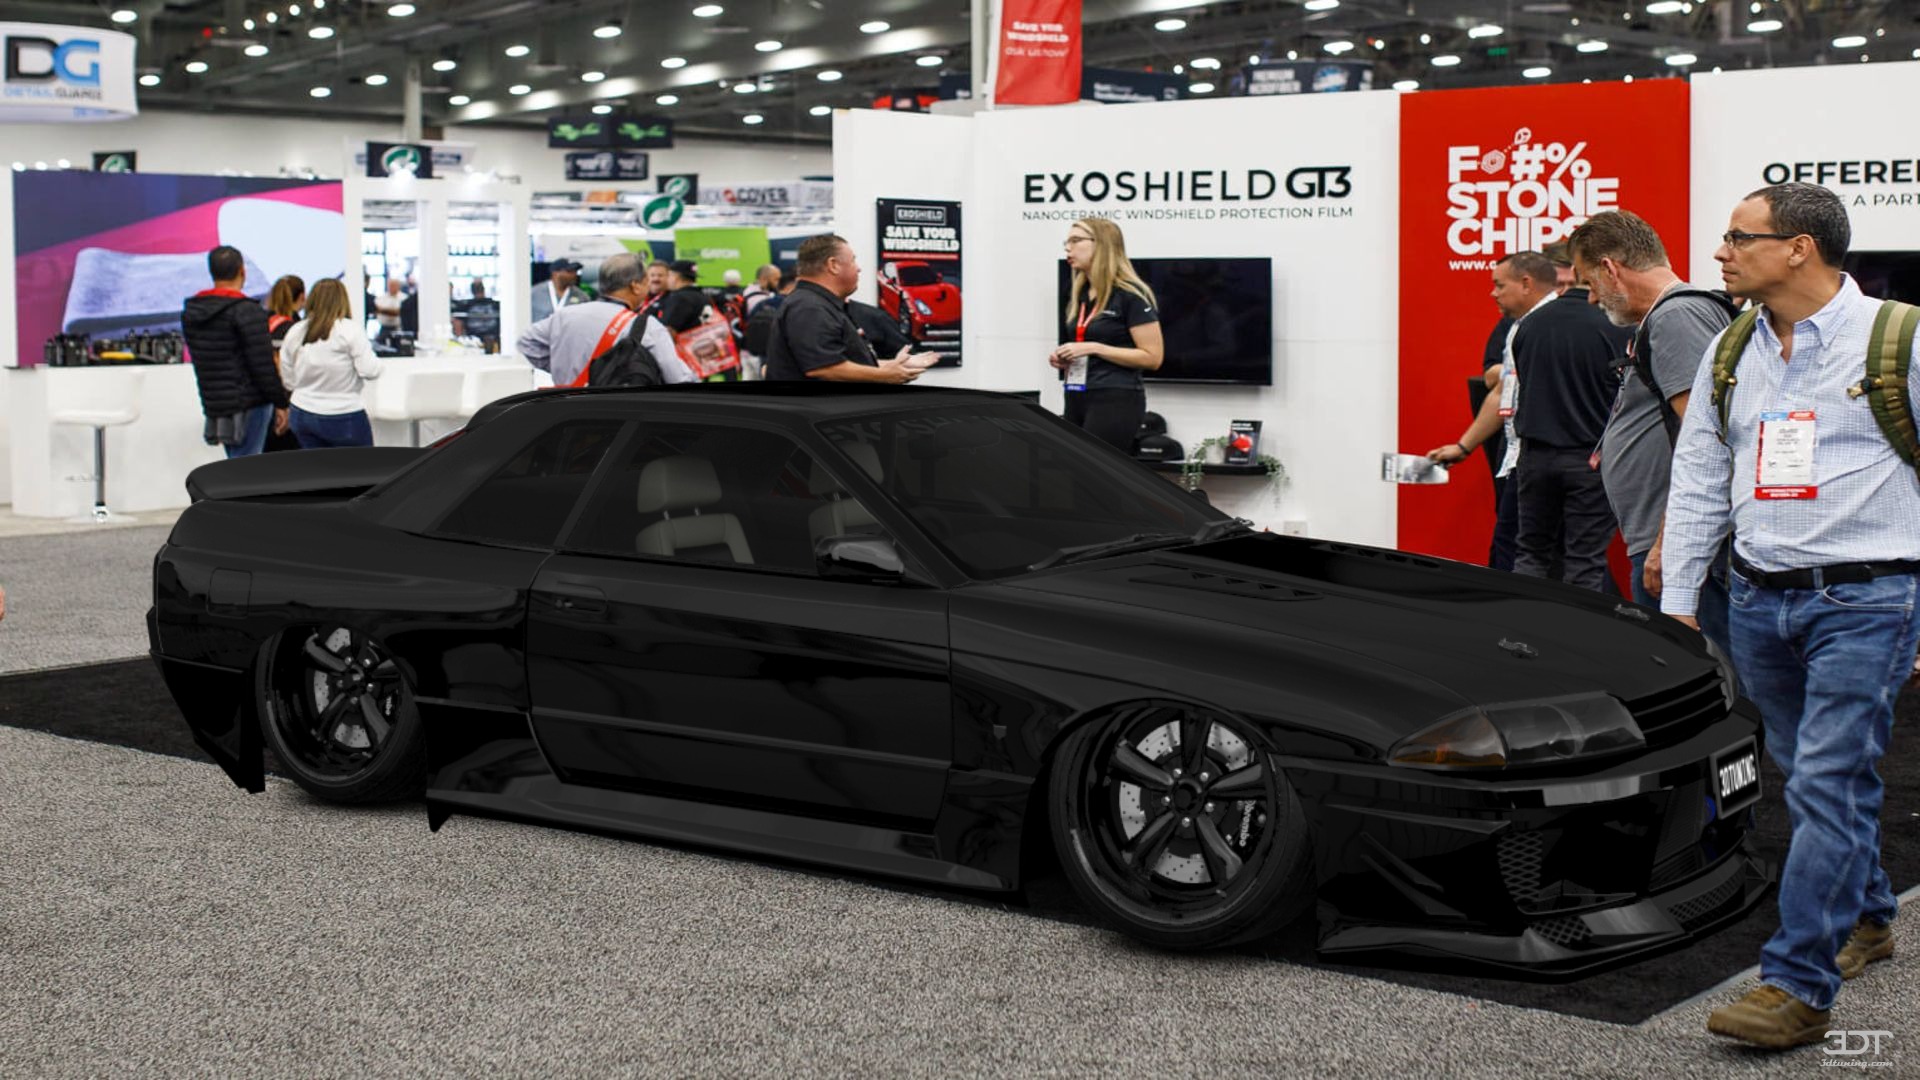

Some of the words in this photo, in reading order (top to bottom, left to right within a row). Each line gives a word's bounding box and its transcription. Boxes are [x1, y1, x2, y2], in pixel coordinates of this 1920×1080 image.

[5, 35, 101, 86] DG
[1763, 160, 1920, 185] OFFERE
[1024, 169, 1276, 203] EXOSHIELD
[1285, 166, 1351, 199] GT3
[739, 188, 789, 203] COVER
[1446, 177, 1619, 219] STONE
[1853, 194, 1866, 206] A
[898, 209, 943, 219] EXOSHIELD
[1022, 210, 1122, 221] NANOCERAMIC
[1126, 209, 1215, 220] WINDSHIELD
[1219, 208, 1313, 219] PROTECTION
[1318, 207, 1353, 218] FILM
[887, 226, 919, 238] SAVE
[922, 228, 955, 239] YOUR
[883, 238, 960, 251] WINDSHIELD
[1719, 754, 1756, 797] 3DTUNING
[1239, 804, 1254, 847] brembo
